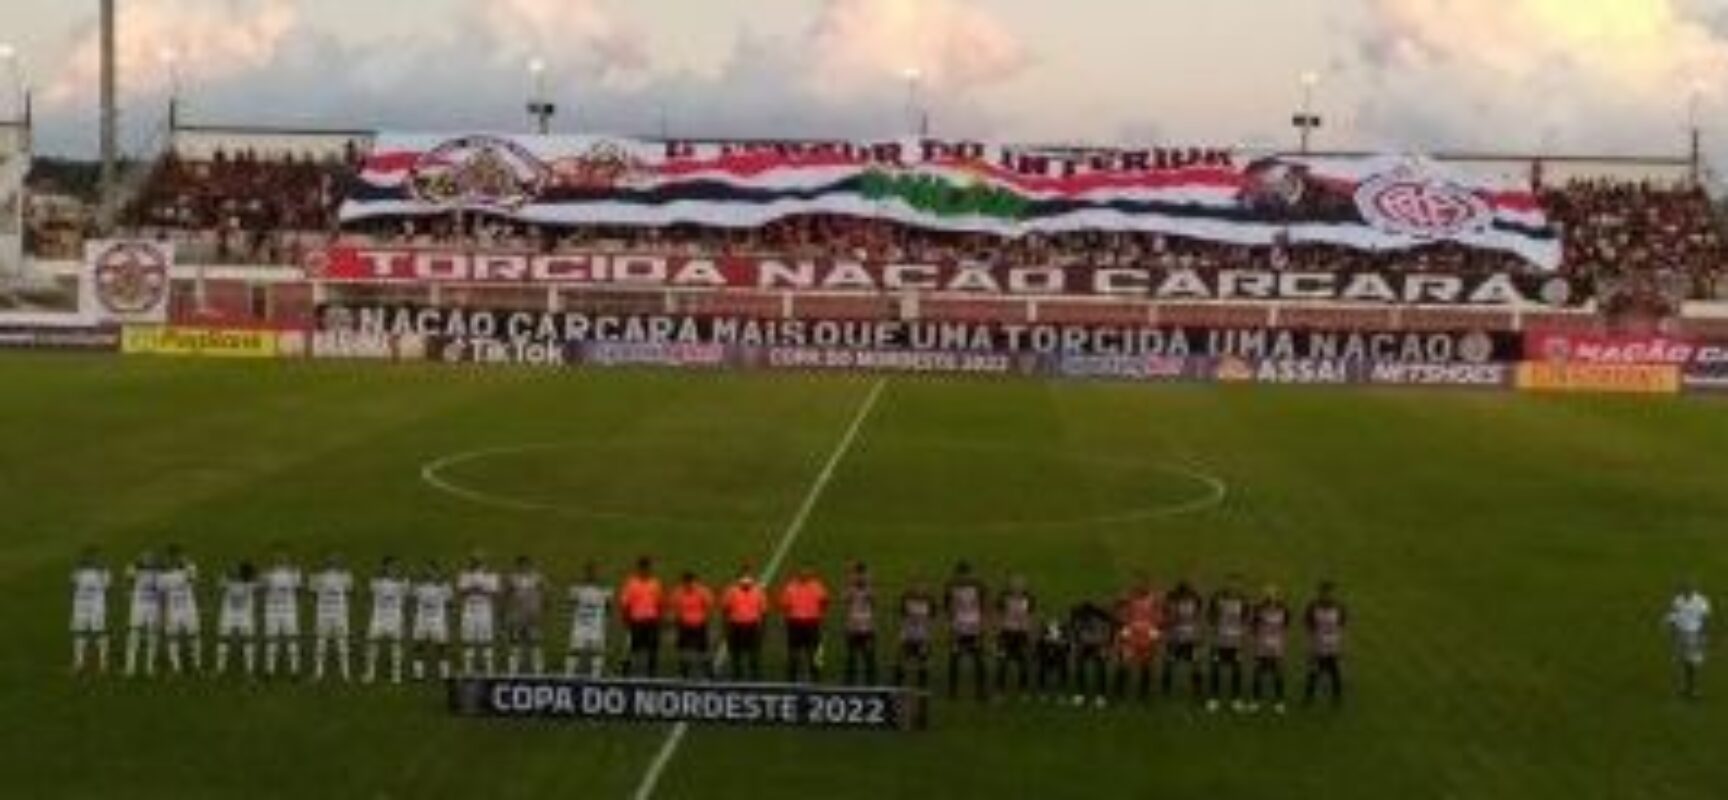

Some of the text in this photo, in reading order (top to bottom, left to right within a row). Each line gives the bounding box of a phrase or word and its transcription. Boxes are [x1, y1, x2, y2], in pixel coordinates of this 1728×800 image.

[357, 251, 728, 283] TORCIDA
[471, 337, 563, 364] TikTok
[814, 320, 903, 347] QUE
[908, 322, 993, 350] UMA
[1000, 325, 1190, 356] TORCIDA
[492, 684, 885, 722] COPA DO NORDESTE 2022
